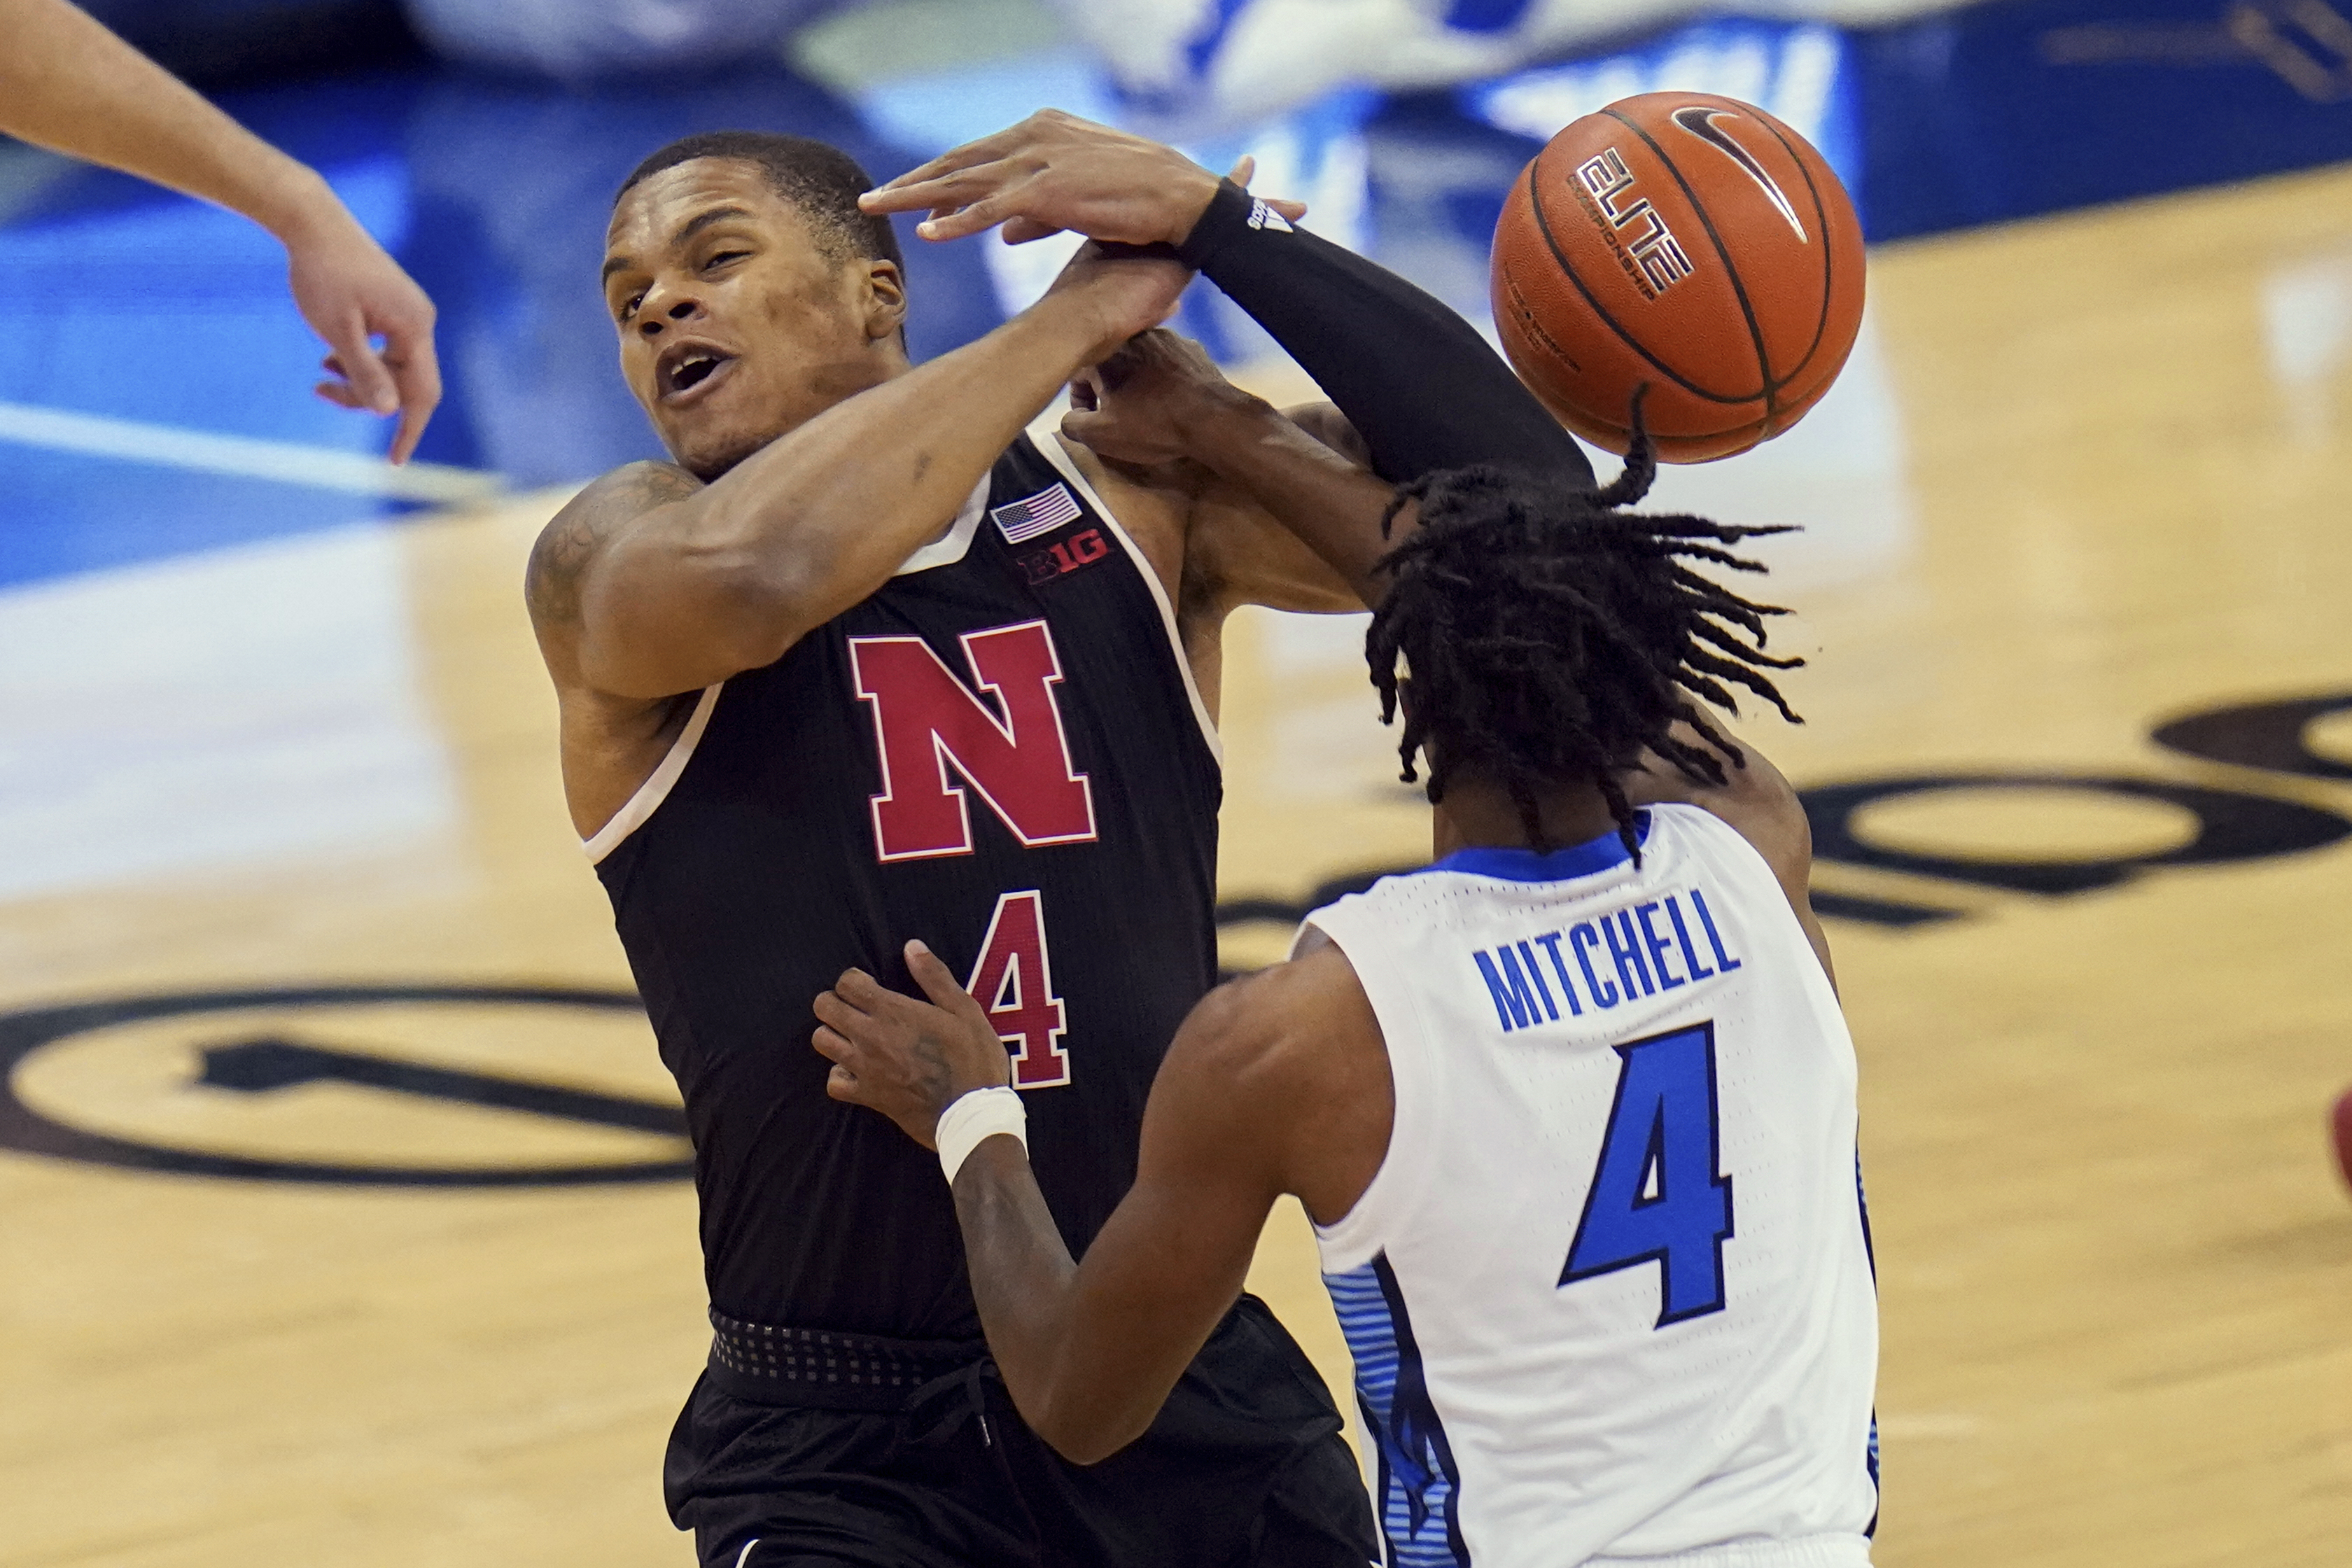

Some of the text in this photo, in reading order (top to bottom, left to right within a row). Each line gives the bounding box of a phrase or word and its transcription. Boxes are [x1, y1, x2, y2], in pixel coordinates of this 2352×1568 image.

[1567, 175, 1655, 300] CHAMPIONSHIP
[1576, 146, 1695, 294] ELITE
[847, 620, 1098, 863] N
[967, 889, 1071, 1090] 4
[1472, 888, 1742, 1032] MITCHELL
[1555, 1018, 1735, 1331] 4
